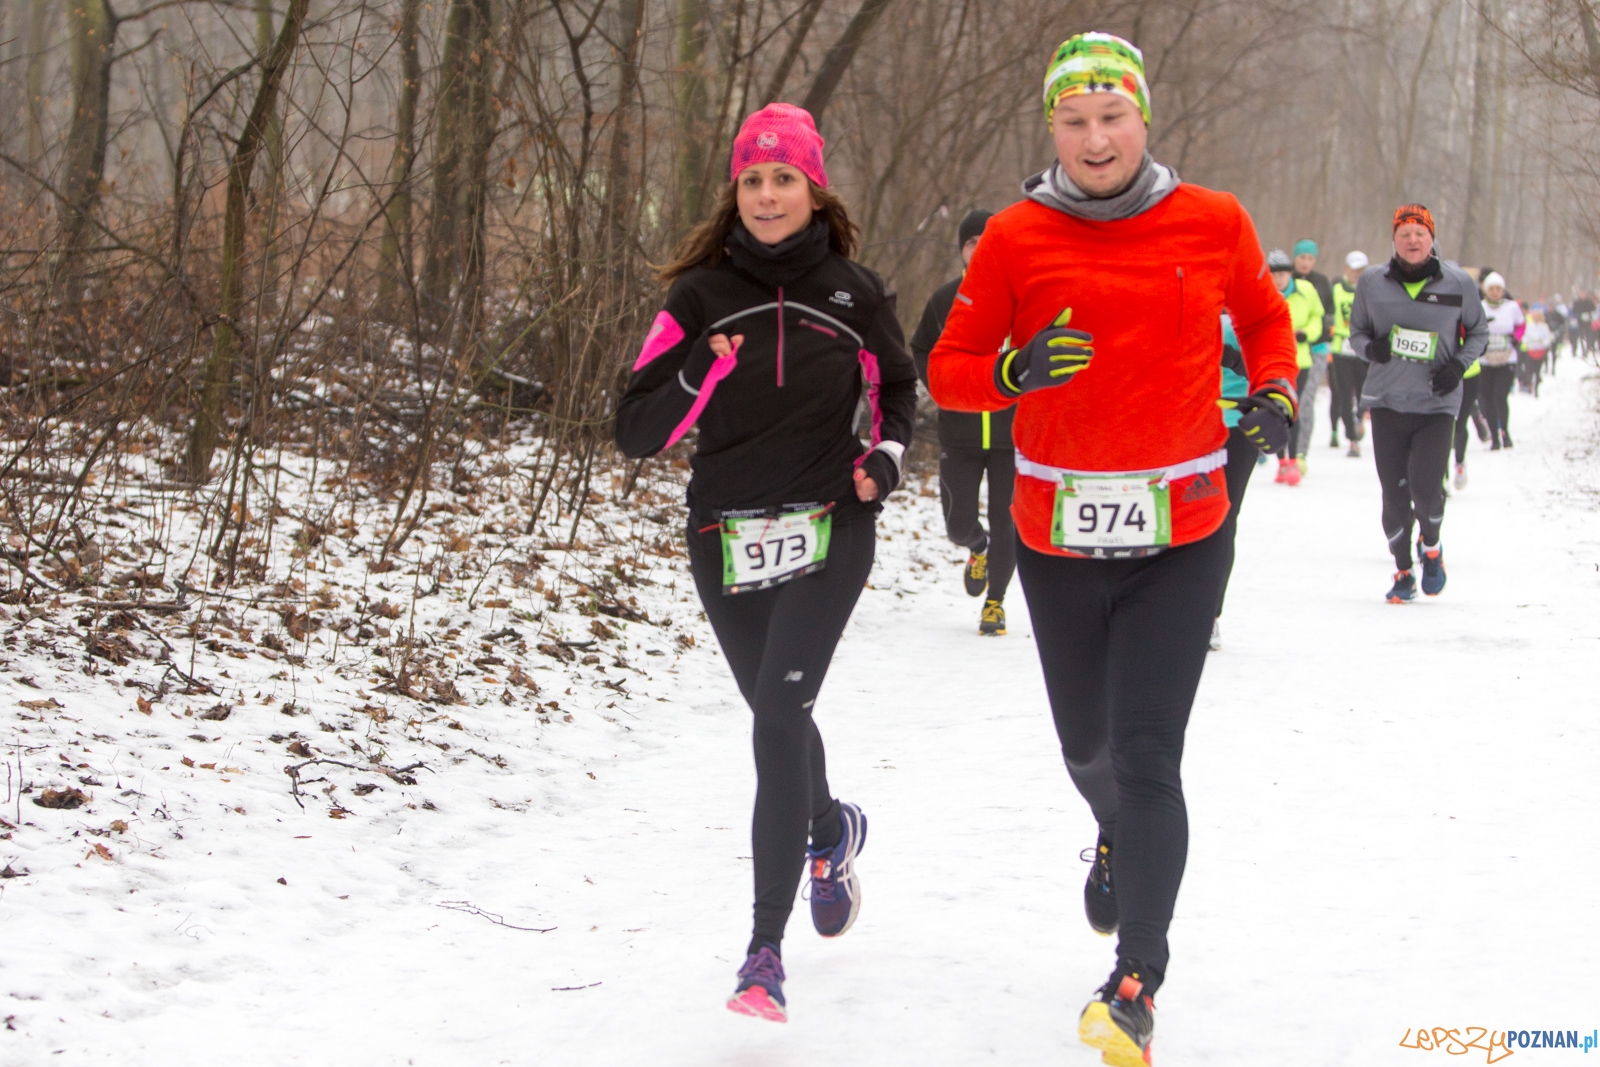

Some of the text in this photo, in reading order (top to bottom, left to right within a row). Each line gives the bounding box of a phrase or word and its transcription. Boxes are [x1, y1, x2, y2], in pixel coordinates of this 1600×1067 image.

[1396, 338, 1428, 353] 1962
[1078, 502, 1146, 533] 974
[745, 534, 806, 570] 973
